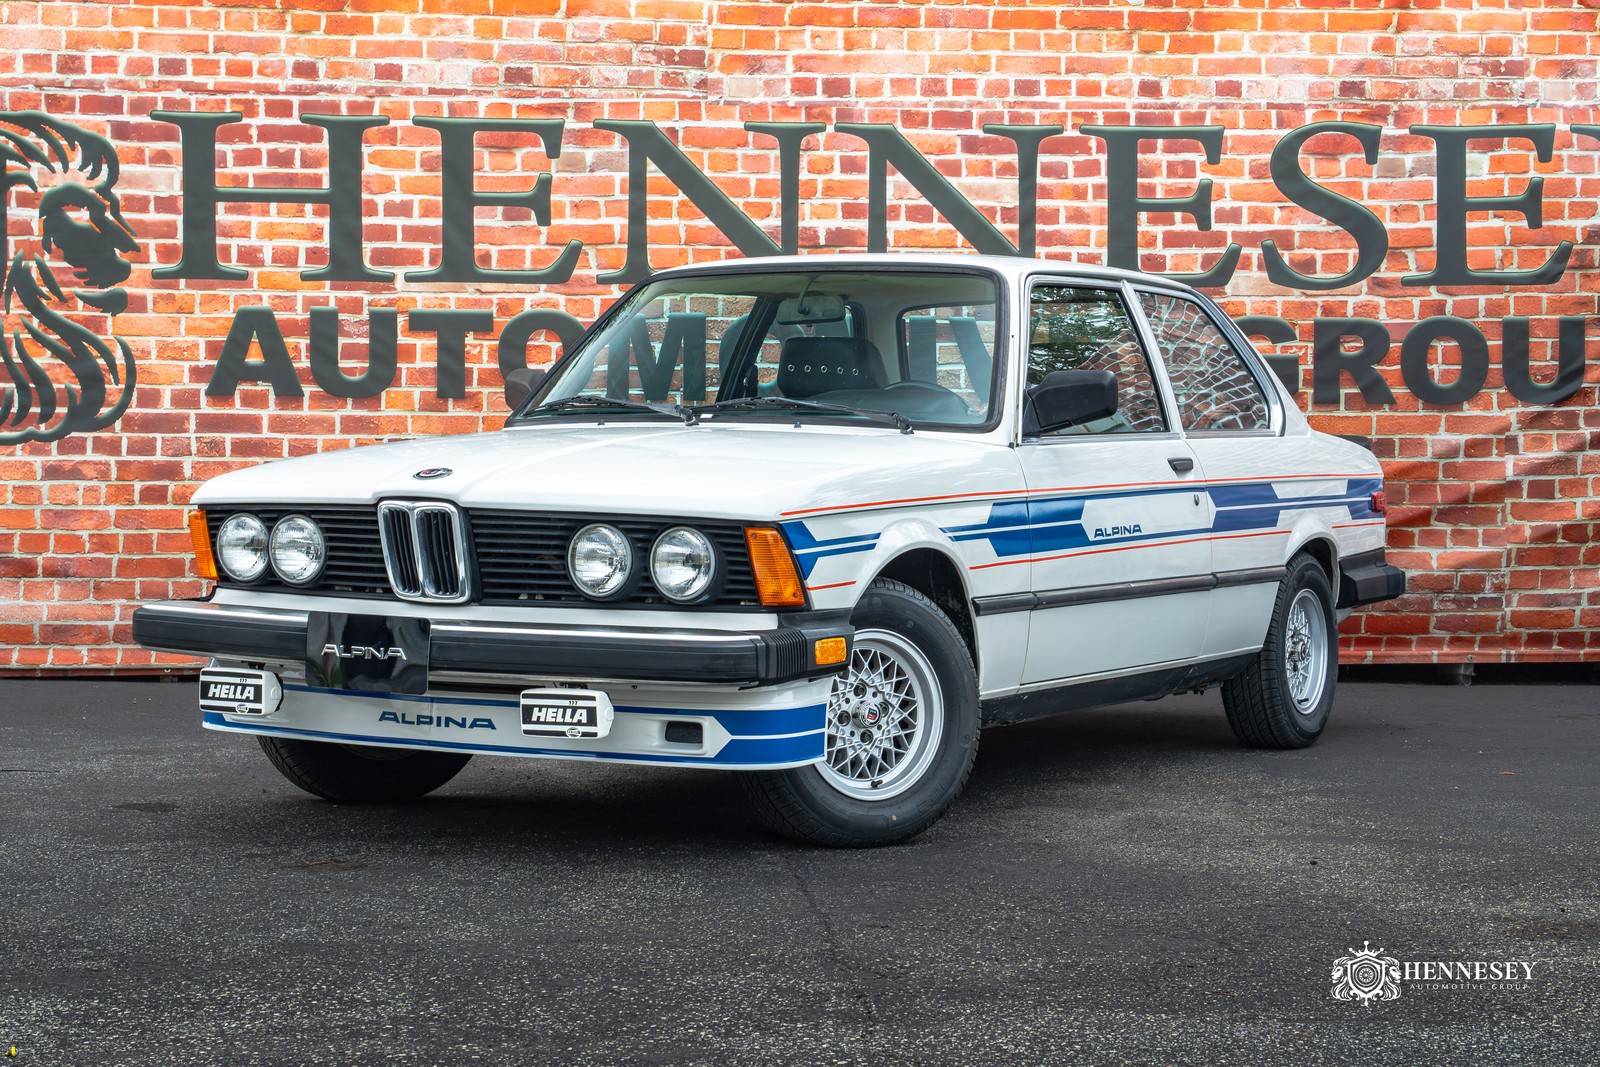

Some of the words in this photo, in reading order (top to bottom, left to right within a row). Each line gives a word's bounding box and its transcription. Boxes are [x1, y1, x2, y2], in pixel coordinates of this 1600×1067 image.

[151, 110, 1600, 289] HENNESE
[1093, 524, 1142, 538] ALPINA
[320, 643, 407, 661] ALPINA
[208, 683, 255, 700] HELLA
[378, 710, 497, 730] ALPINA
[531, 707, 587, 724] HELLA
